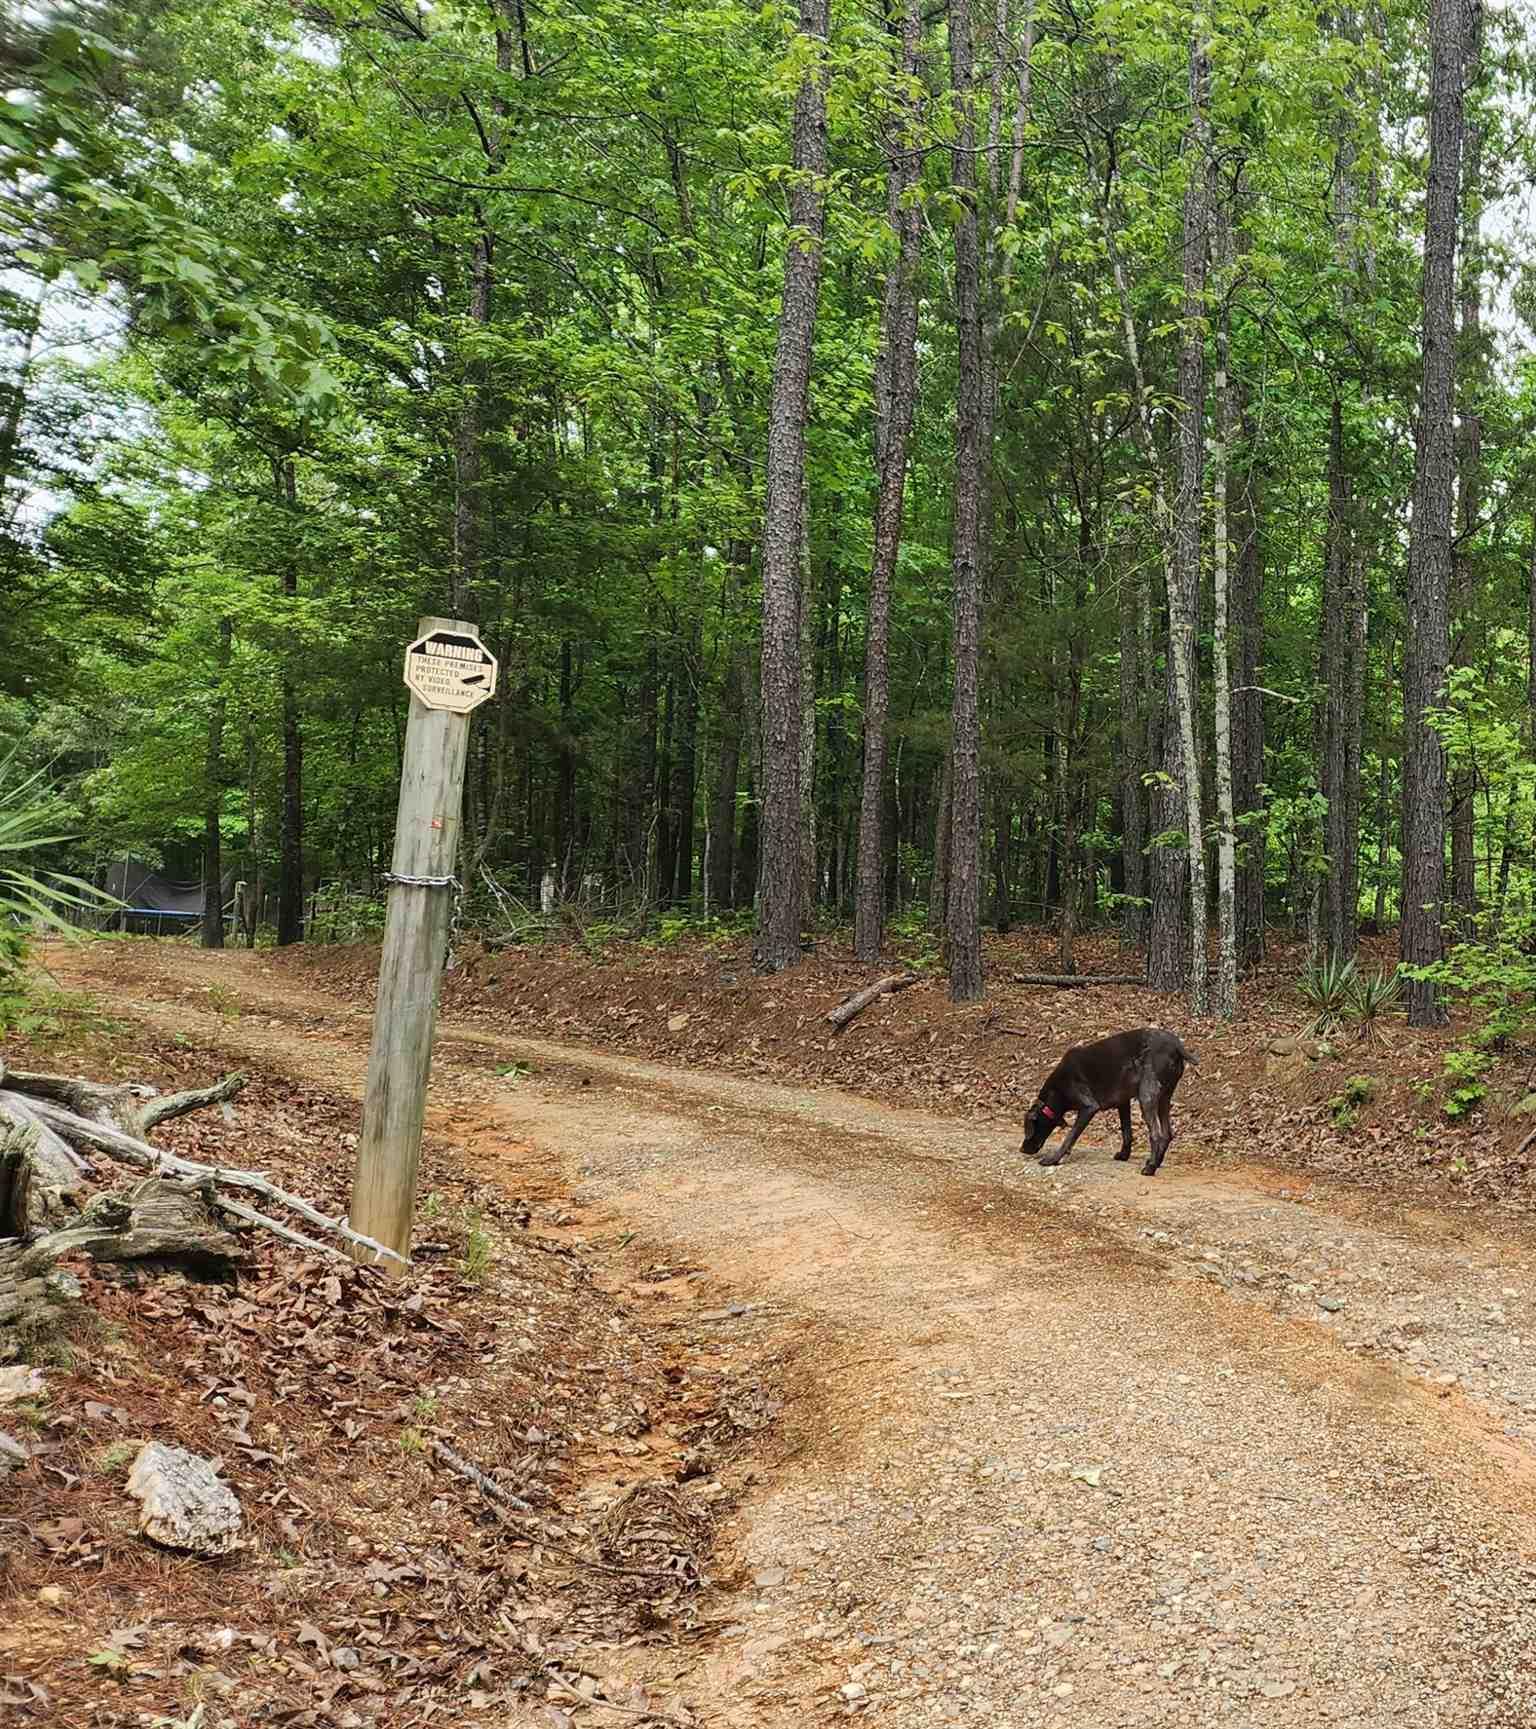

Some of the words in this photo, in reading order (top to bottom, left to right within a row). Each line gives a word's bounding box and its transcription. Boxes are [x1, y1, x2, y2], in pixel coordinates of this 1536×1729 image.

[425, 641, 483, 662] WARNING
[418, 656, 441, 665] THESE
[416, 665, 460, 678] PROTECTED
[428, 676, 450, 685] VIDEO
[423, 684, 473, 697] SURVEILLANCE
